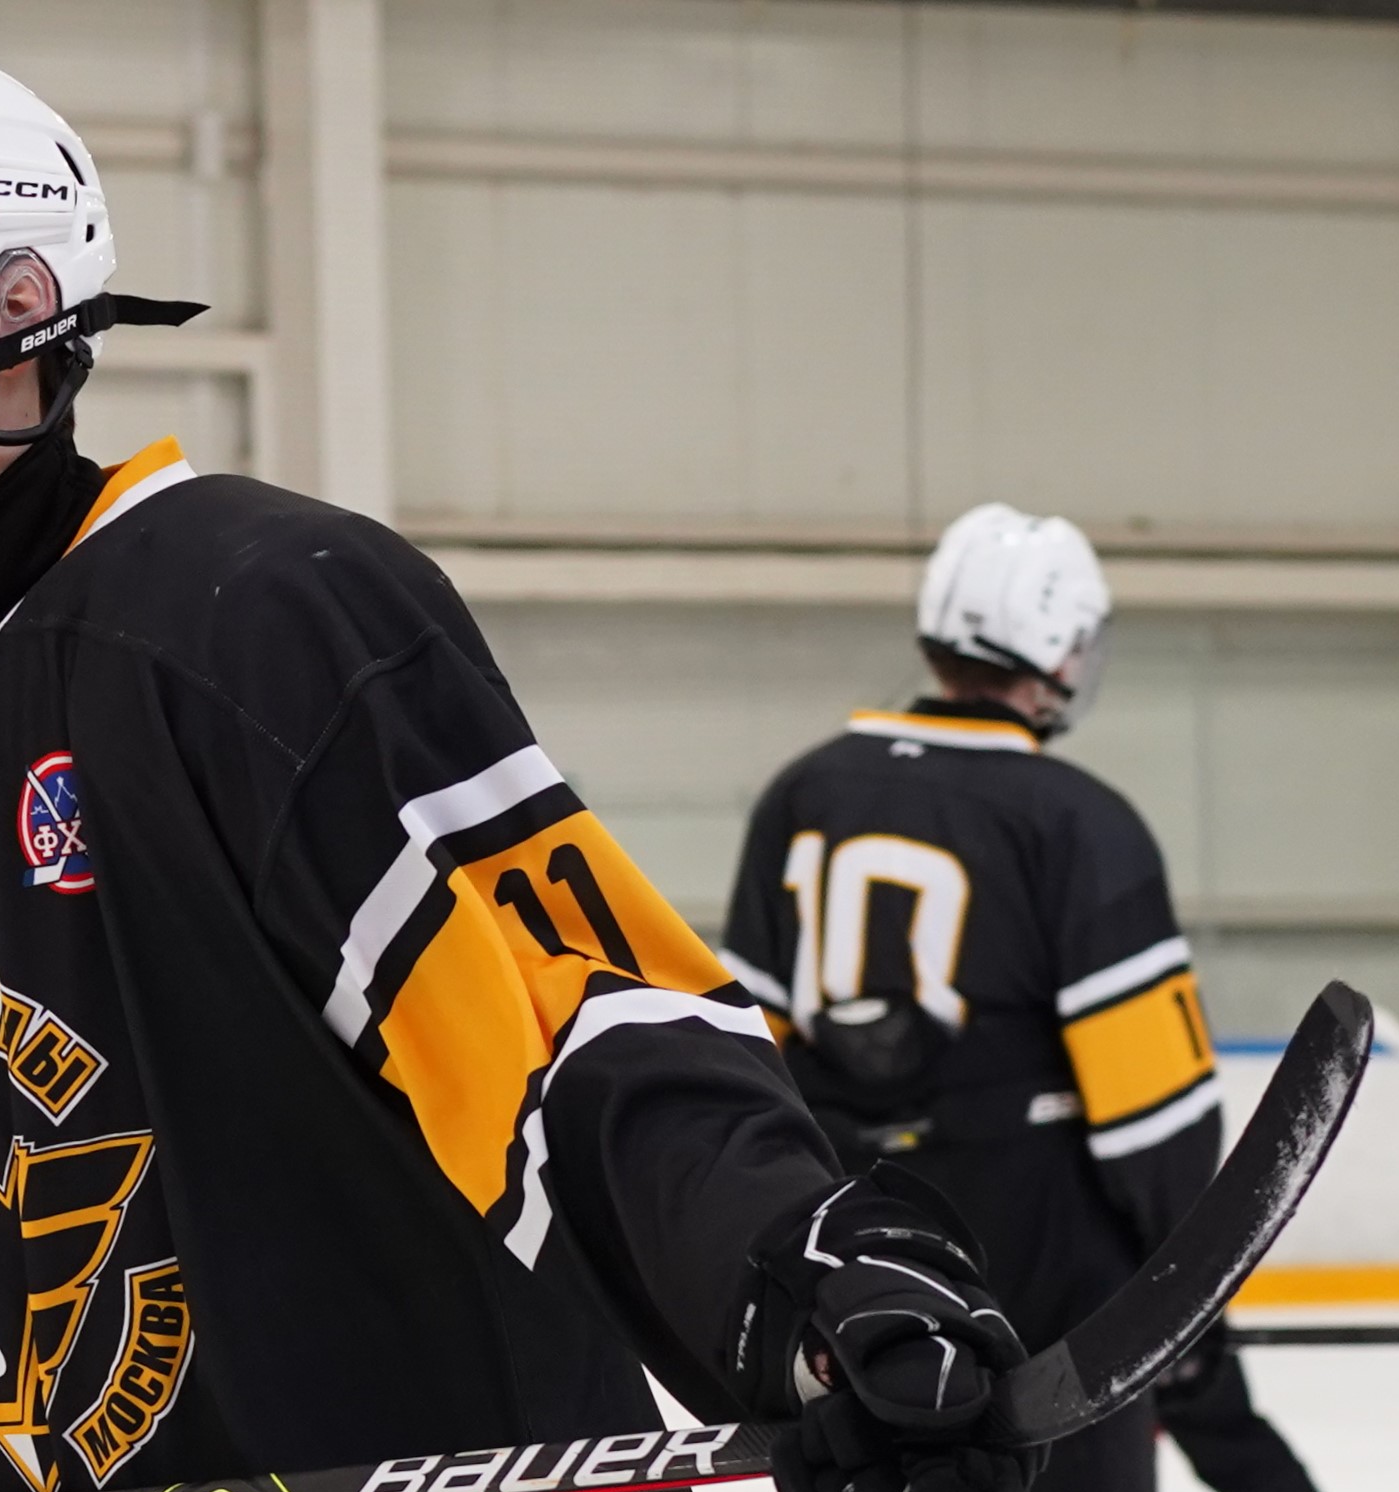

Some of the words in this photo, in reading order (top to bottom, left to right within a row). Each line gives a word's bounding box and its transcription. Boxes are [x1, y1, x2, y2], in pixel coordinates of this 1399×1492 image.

[21, 314, 78, 353] BAUER
[494, 843, 646, 983] 11
[783, 828, 970, 1040] 10
[70, 1262, 191, 1480] МОСКВА
